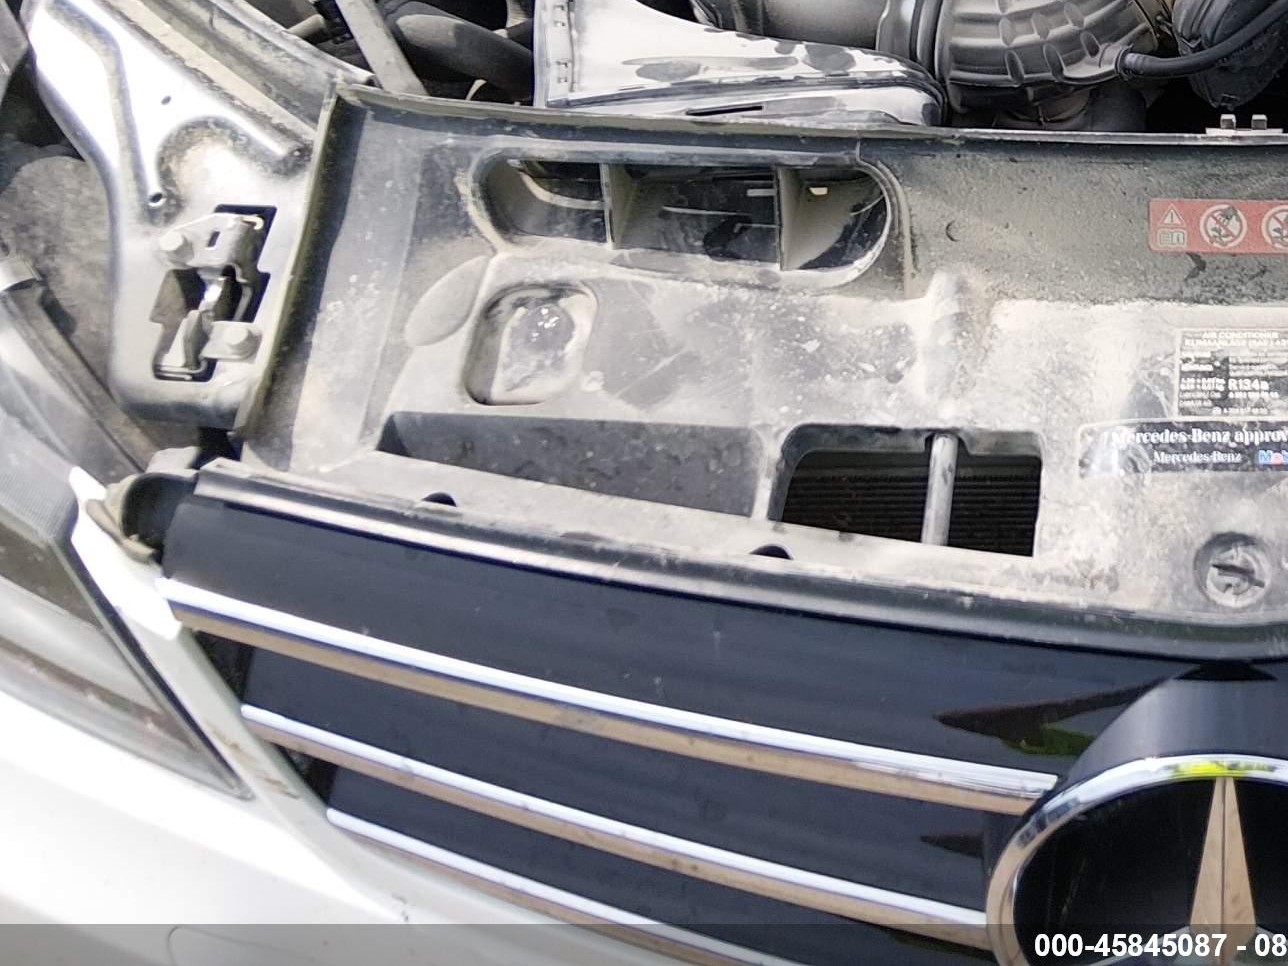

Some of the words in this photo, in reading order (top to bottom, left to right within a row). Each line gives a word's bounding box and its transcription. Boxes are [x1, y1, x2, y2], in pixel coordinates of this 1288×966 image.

[1202, 331, 1217, 339] AIR
[1227, 378, 1270, 391] R134a
[1153, 450, 1241, 464] Mercedes-Benz
